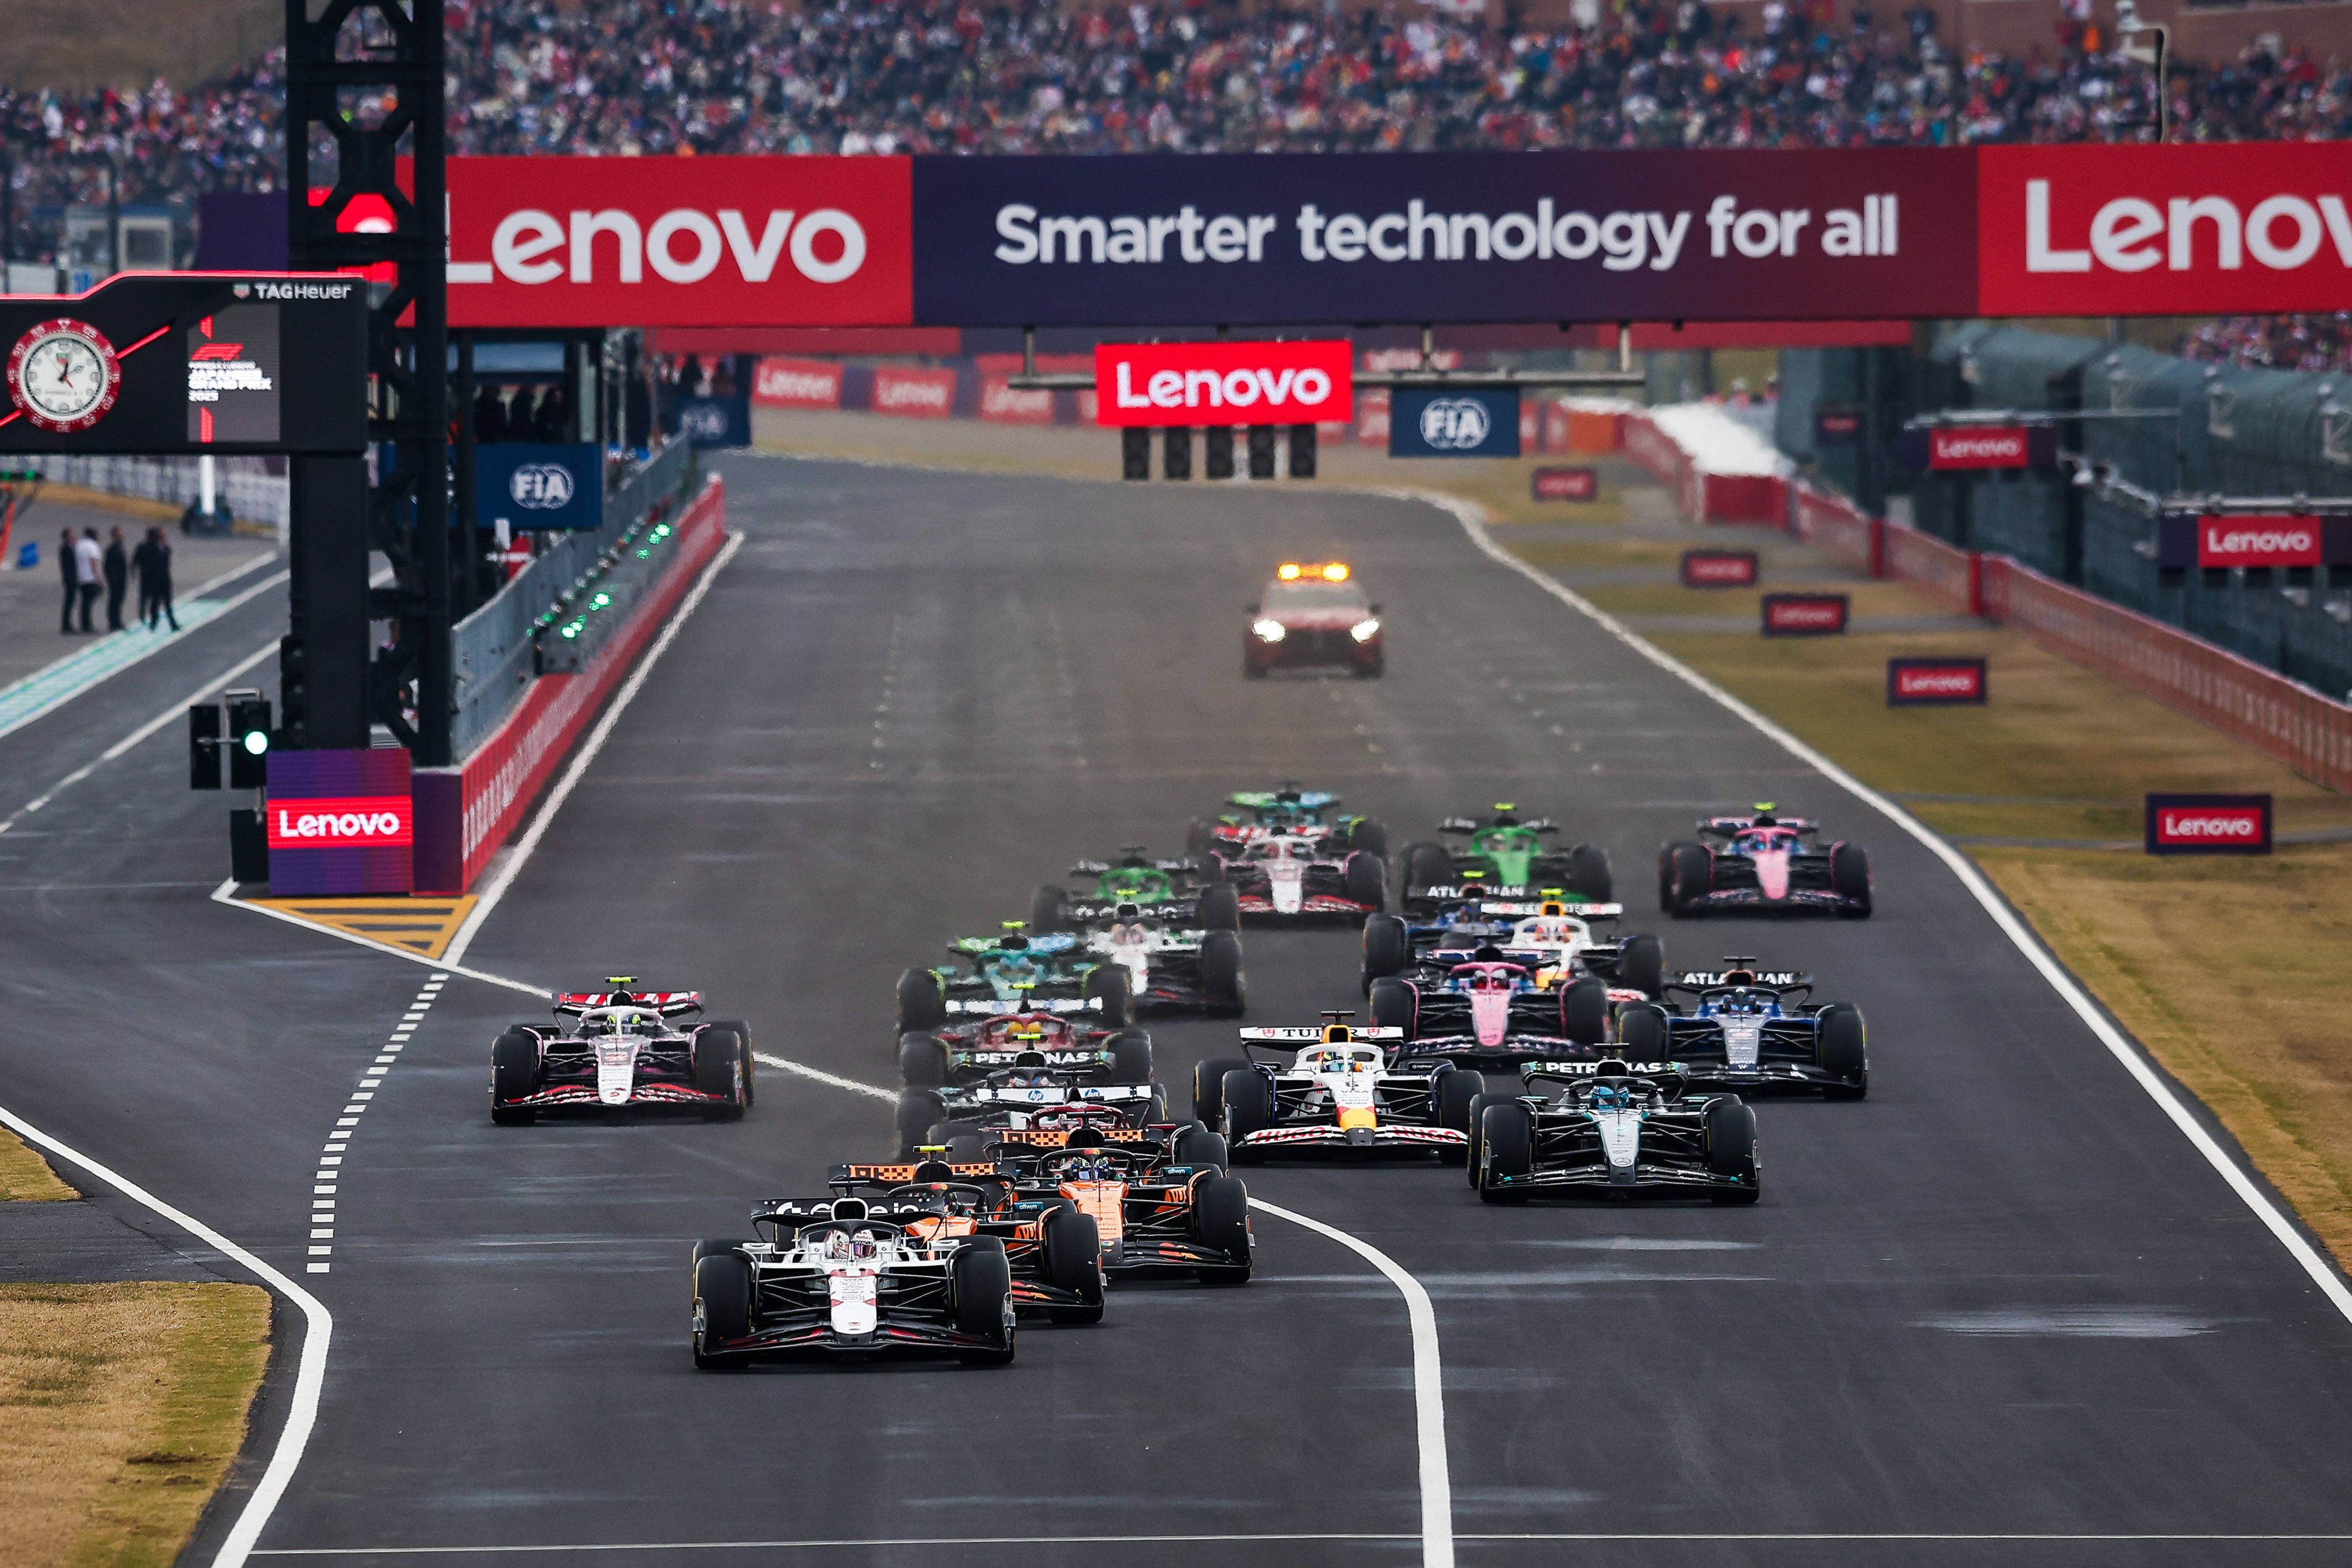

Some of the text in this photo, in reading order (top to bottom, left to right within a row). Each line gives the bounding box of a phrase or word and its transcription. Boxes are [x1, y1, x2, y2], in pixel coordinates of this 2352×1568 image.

[994, 193, 1898, 272] Smarter technology for all
[2025, 179, 2352, 273] Leno
[446, 190, 867, 285] Lenovo
[1116, 361, 1332, 408] Lenovo
[1937, 438, 2022, 459] Lenovo
[2208, 529, 2312, 553] Lenovo
[279, 810, 400, 838] Lenovo
[2166, 815, 2253, 837] Lenovo
[1682, 972, 1792, 985] ATLAIAN
[975, 1052, 1090, 1064] PETNAS
[1545, 1062, 1662, 1074] PETRAS
[1029, 1090, 1043, 1101] hp
[1254, 1126, 1325, 1144] HUGO
[1392, 1126, 1461, 1142] HUGO
